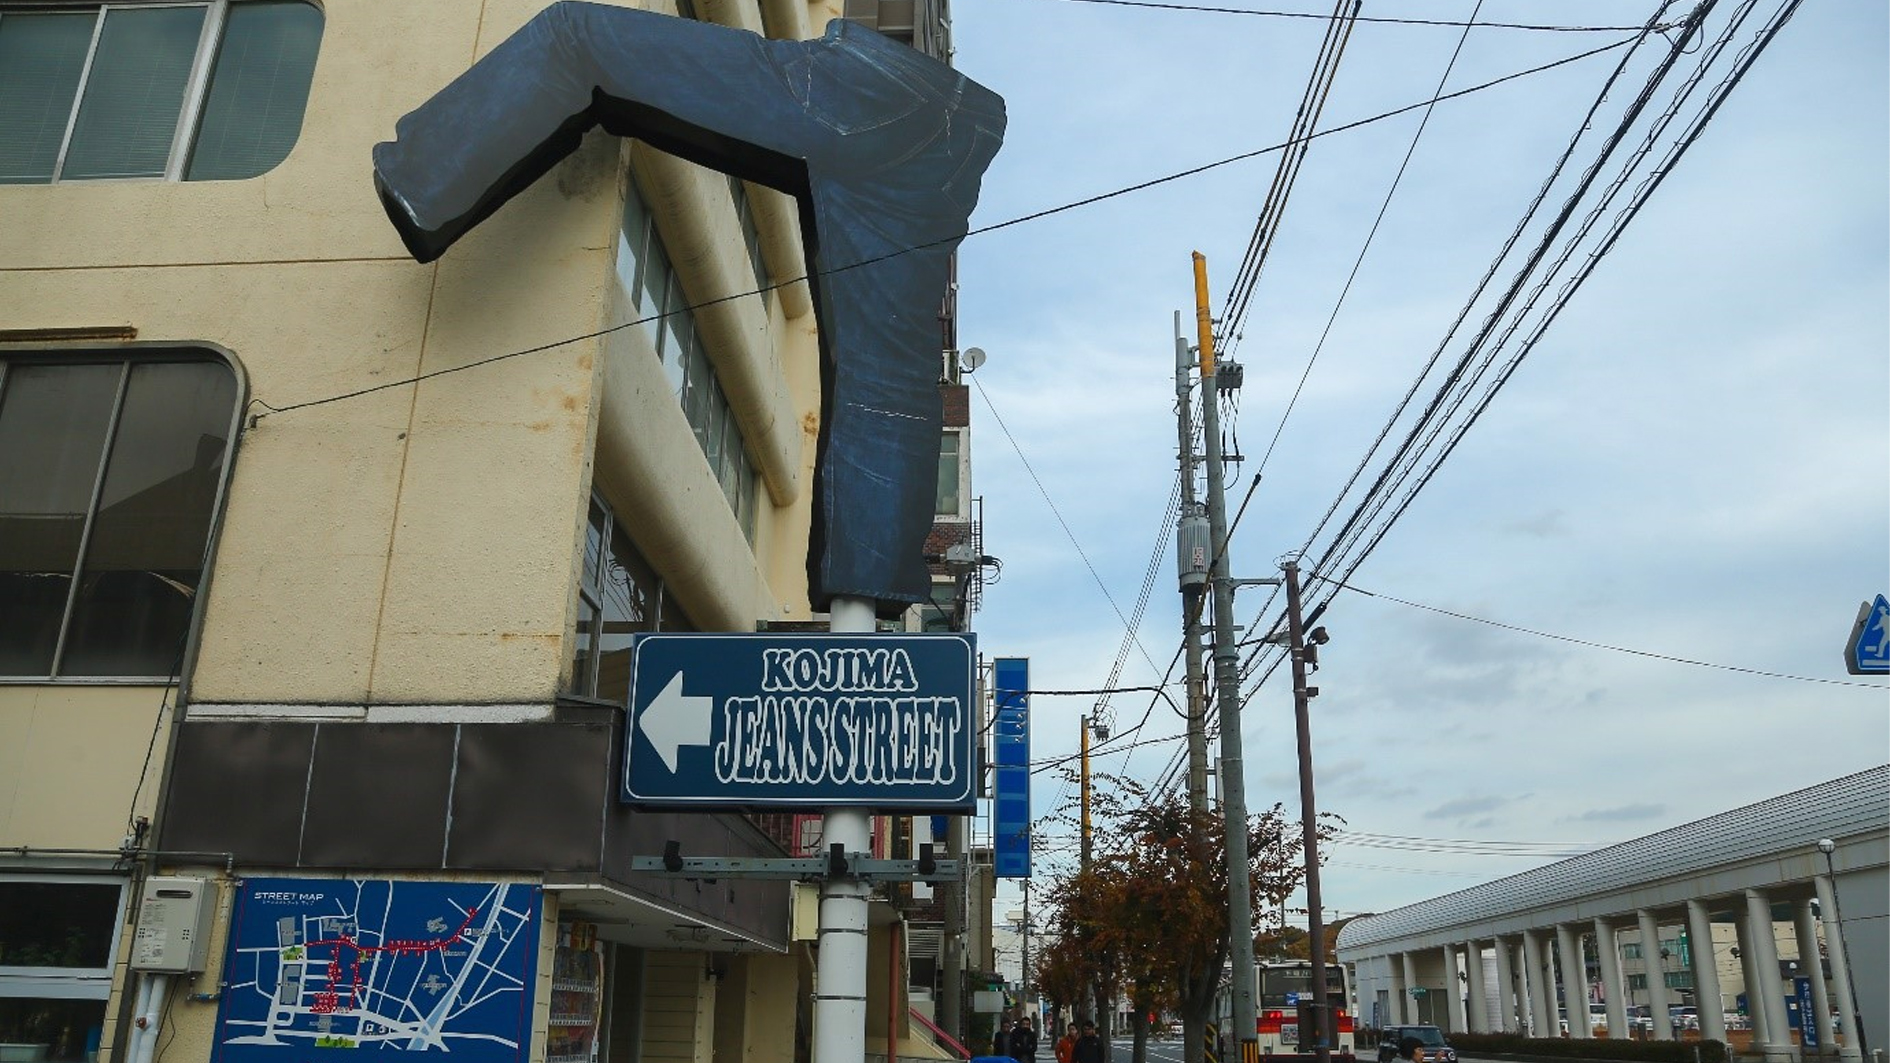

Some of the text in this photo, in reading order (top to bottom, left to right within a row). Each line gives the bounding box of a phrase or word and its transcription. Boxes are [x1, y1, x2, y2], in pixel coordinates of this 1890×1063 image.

[762, 648, 919, 691] KOJIMA
[254, 892, 324, 901] STREET MAP
